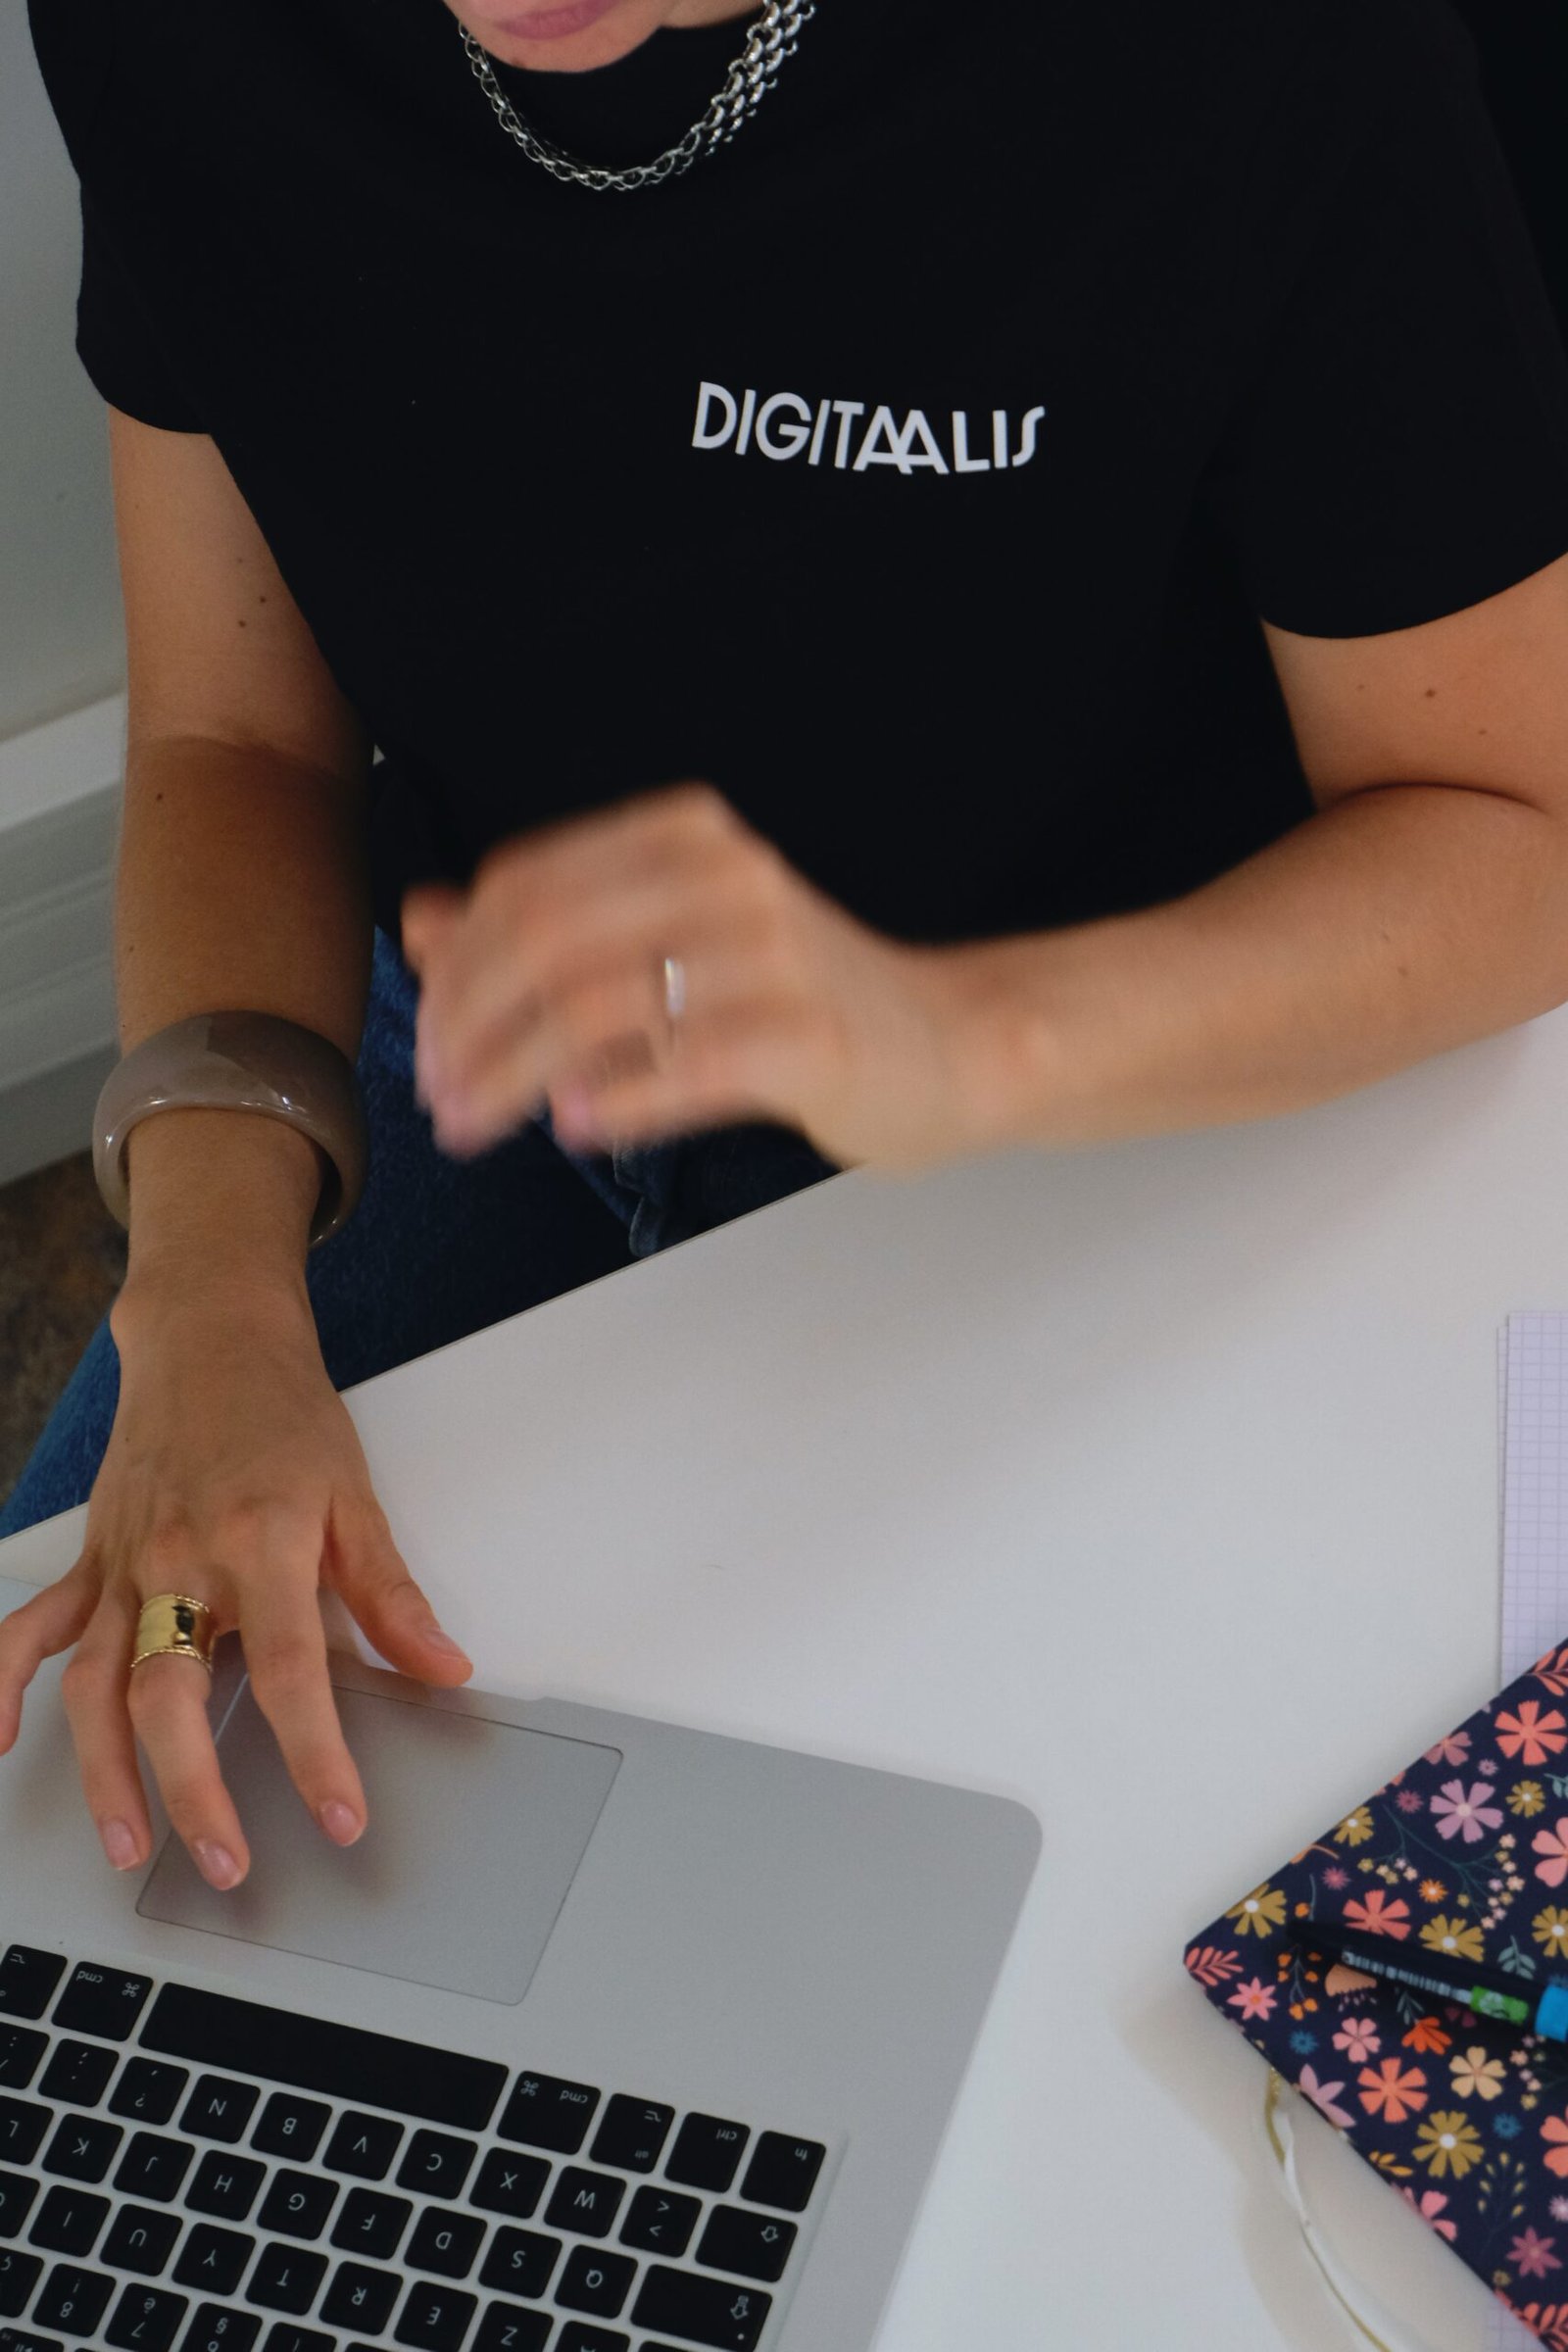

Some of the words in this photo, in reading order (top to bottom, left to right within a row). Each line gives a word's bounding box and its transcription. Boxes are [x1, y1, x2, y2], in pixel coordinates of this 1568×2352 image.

[692, 381, 1046, 475] DIGITAALIS
[75, 1970, 103, 1984] cmd
[559, 2089, 589, 2104] cmd
[208, 2098, 227, 2117] N
[9, 2120, 20, 2137] L
[281, 2117, 298, 2135] B
[715, 2129, 738, 2140] ctrl
[72, 2137, 90, 2156] K
[352, 2135, 368, 2153] V
[426, 2153, 443, 2172] C
[794, 2147, 808, 2161] fn
[145, 2156, 159, 2173] J
[214, 2174, 233, 2193] H
[500, 2172, 518, 2190] X
[288, 2192, 306, 2212] G
[573, 2189, 596, 2210] W
[63, 2211, 73, 2228] I
[361, 2214, 376, 2231] F
[128, 2229, 147, 2247] U
[435, 2230, 453, 2250] D
[202, 2249, 217, 2267] Y
[511, 2250, 526, 2269] S
[276, 2269, 289, 2287] T
[585, 2269, 604, 2289] Q
[351, 2286, 368, 2306] R
[60, 2301, 74, 2319] 8
[426, 2306, 442, 2326] E
[130, 2322, 146, 2338] 7
[500, 2326, 518, 2346] Z
